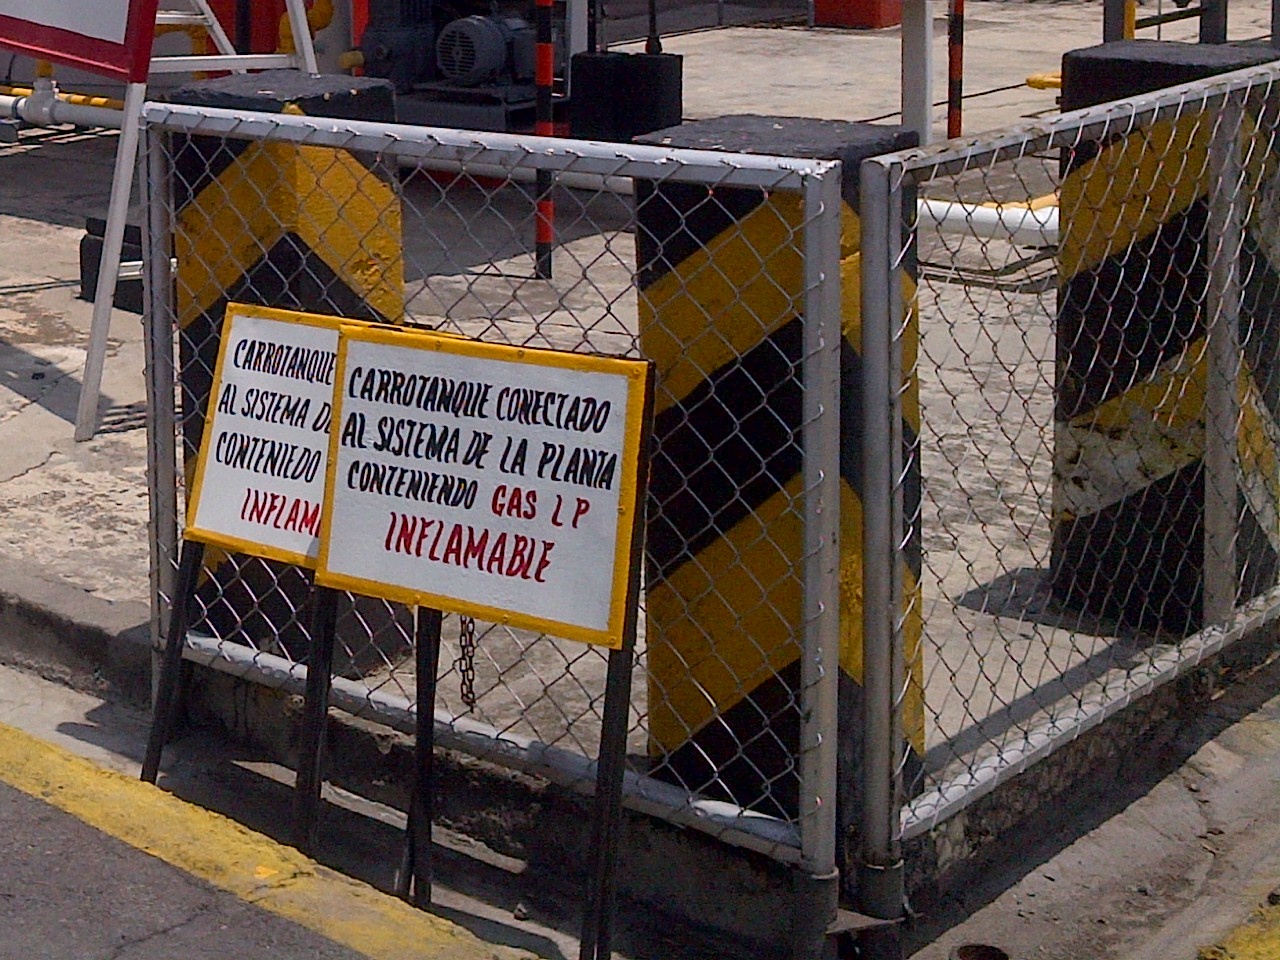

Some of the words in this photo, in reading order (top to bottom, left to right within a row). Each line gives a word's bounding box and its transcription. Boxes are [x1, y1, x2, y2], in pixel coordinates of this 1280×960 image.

[233, 339, 337, 385] CARROTANQUE
[218, 383, 237, 415] AL
[241, 388, 311, 429] SISTEMA
[349, 366, 492, 419] CARROTANQUE
[496, 386, 611, 434] CONECTADO
[216, 431, 322, 483] CONTENIEDO
[341, 412, 367, 449] AL
[373, 415, 461, 464] SISTEMA
[462, 430, 492, 469] DE
[499, 436, 528, 476] LA
[538, 441, 618, 490] PLANTA
[240, 488, 321, 538] INFLAM
[347, 460, 478, 509] CONTENIENDO
[491, 485, 537, 520] GAS
[551, 494, 563, 527] L
[571, 497, 590, 528] P
[384, 511, 555, 582] INFLAMABLE
